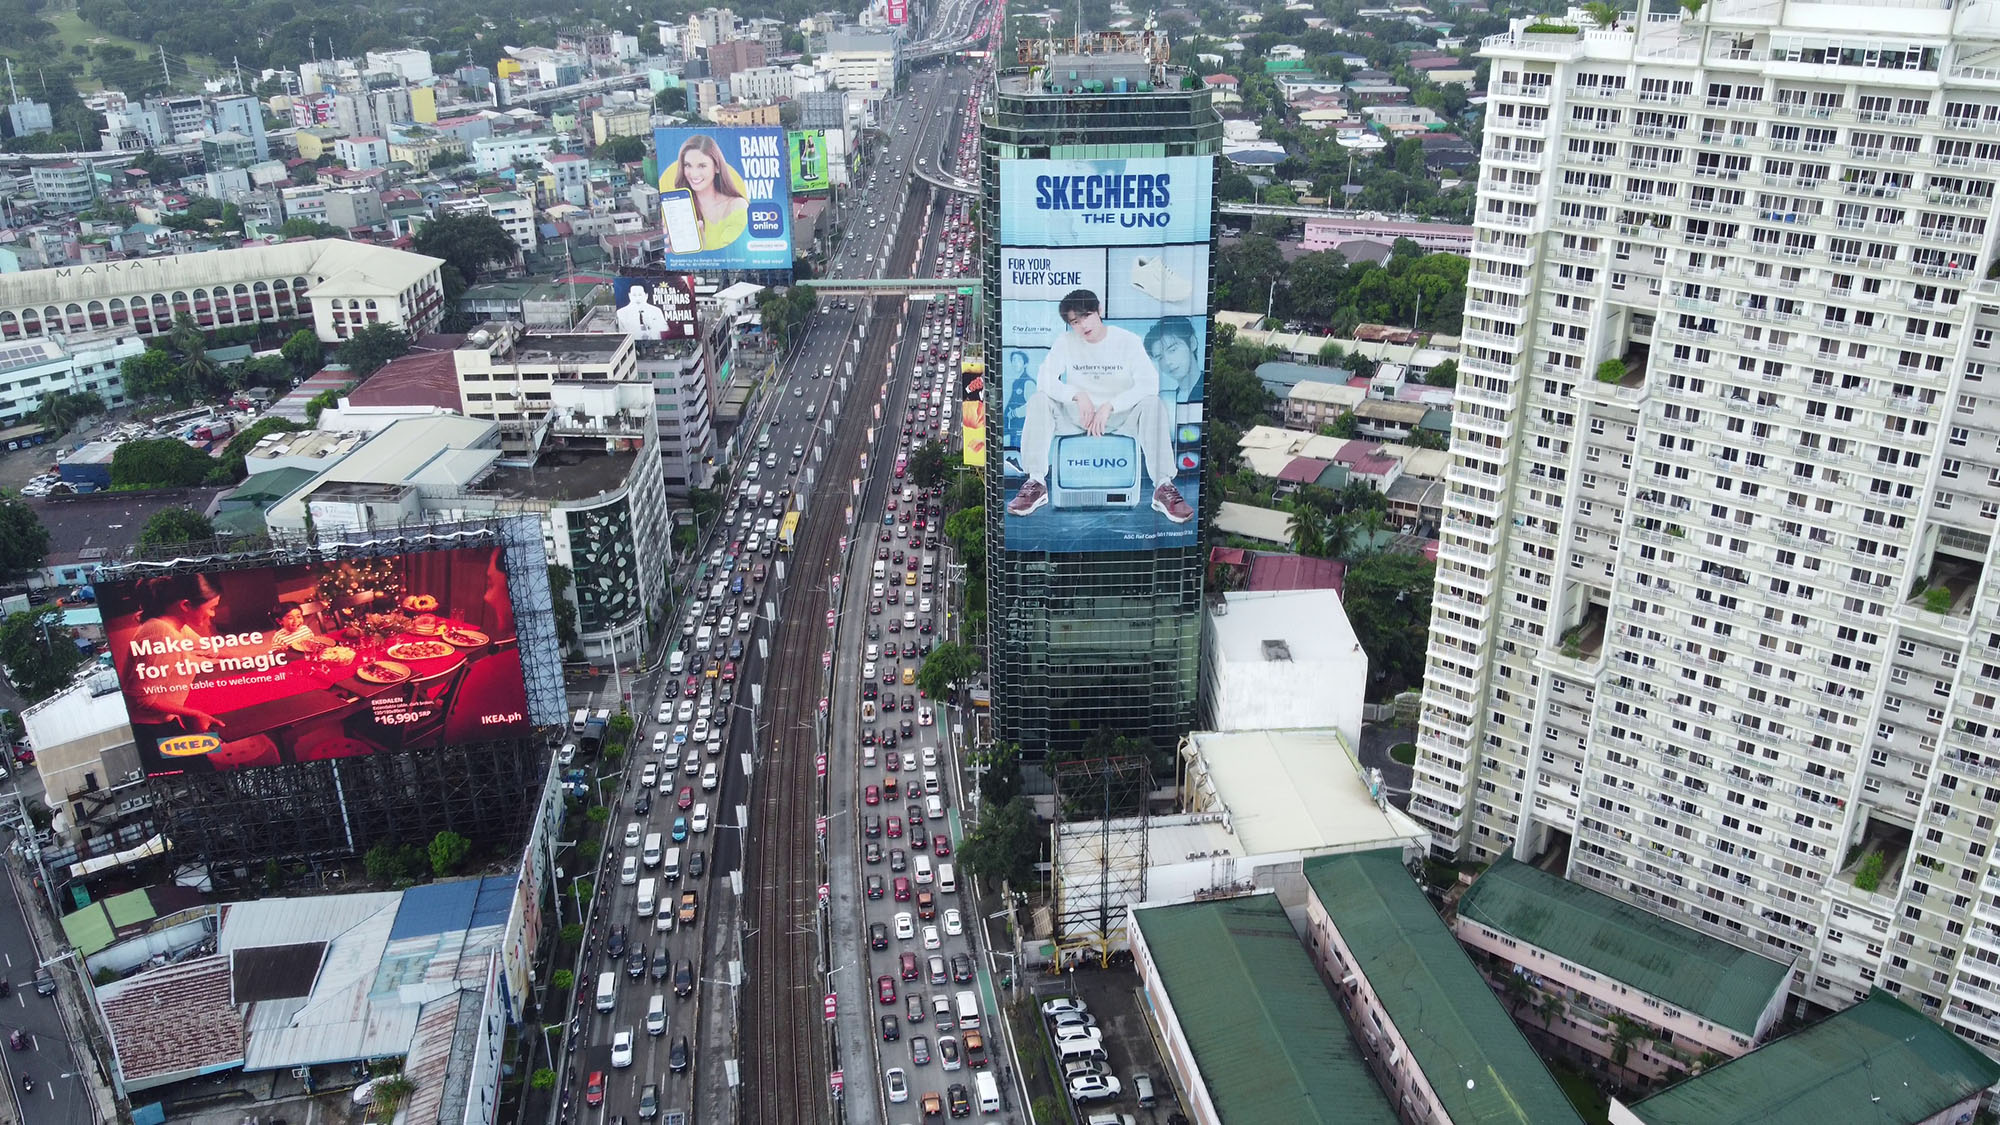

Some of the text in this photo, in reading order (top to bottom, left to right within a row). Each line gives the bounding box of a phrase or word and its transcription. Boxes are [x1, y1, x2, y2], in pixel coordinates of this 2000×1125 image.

[740, 135, 779, 157] BANK
[741, 157, 780, 179] YOUR
[744, 179, 774, 200] WAY
[1036, 173, 1170, 210] SKECHERS
[752, 211, 778, 221] BDO
[1082, 212, 1170, 228] THE UNO
[753, 222, 779, 230] online
[56, 256, 178, 278] MAKATI
[1008, 258, 1051, 271] FOR YOUR
[1012, 271, 1082, 286] EVERY SCENE
[653, 293, 690, 305] PILIPINAS
[664, 310, 694, 321] MAHAL
[1067, 458, 1128, 468] THE UNO
[129, 631, 264, 657] Make space
[135, 651, 288, 680] for the magic
[143, 672, 286, 695] With one table to welcome all
[371, 697, 403, 705] EKEDALEN
[481, 711, 522, 725] IKEA.ph
[165, 739, 214, 752] IKEA
